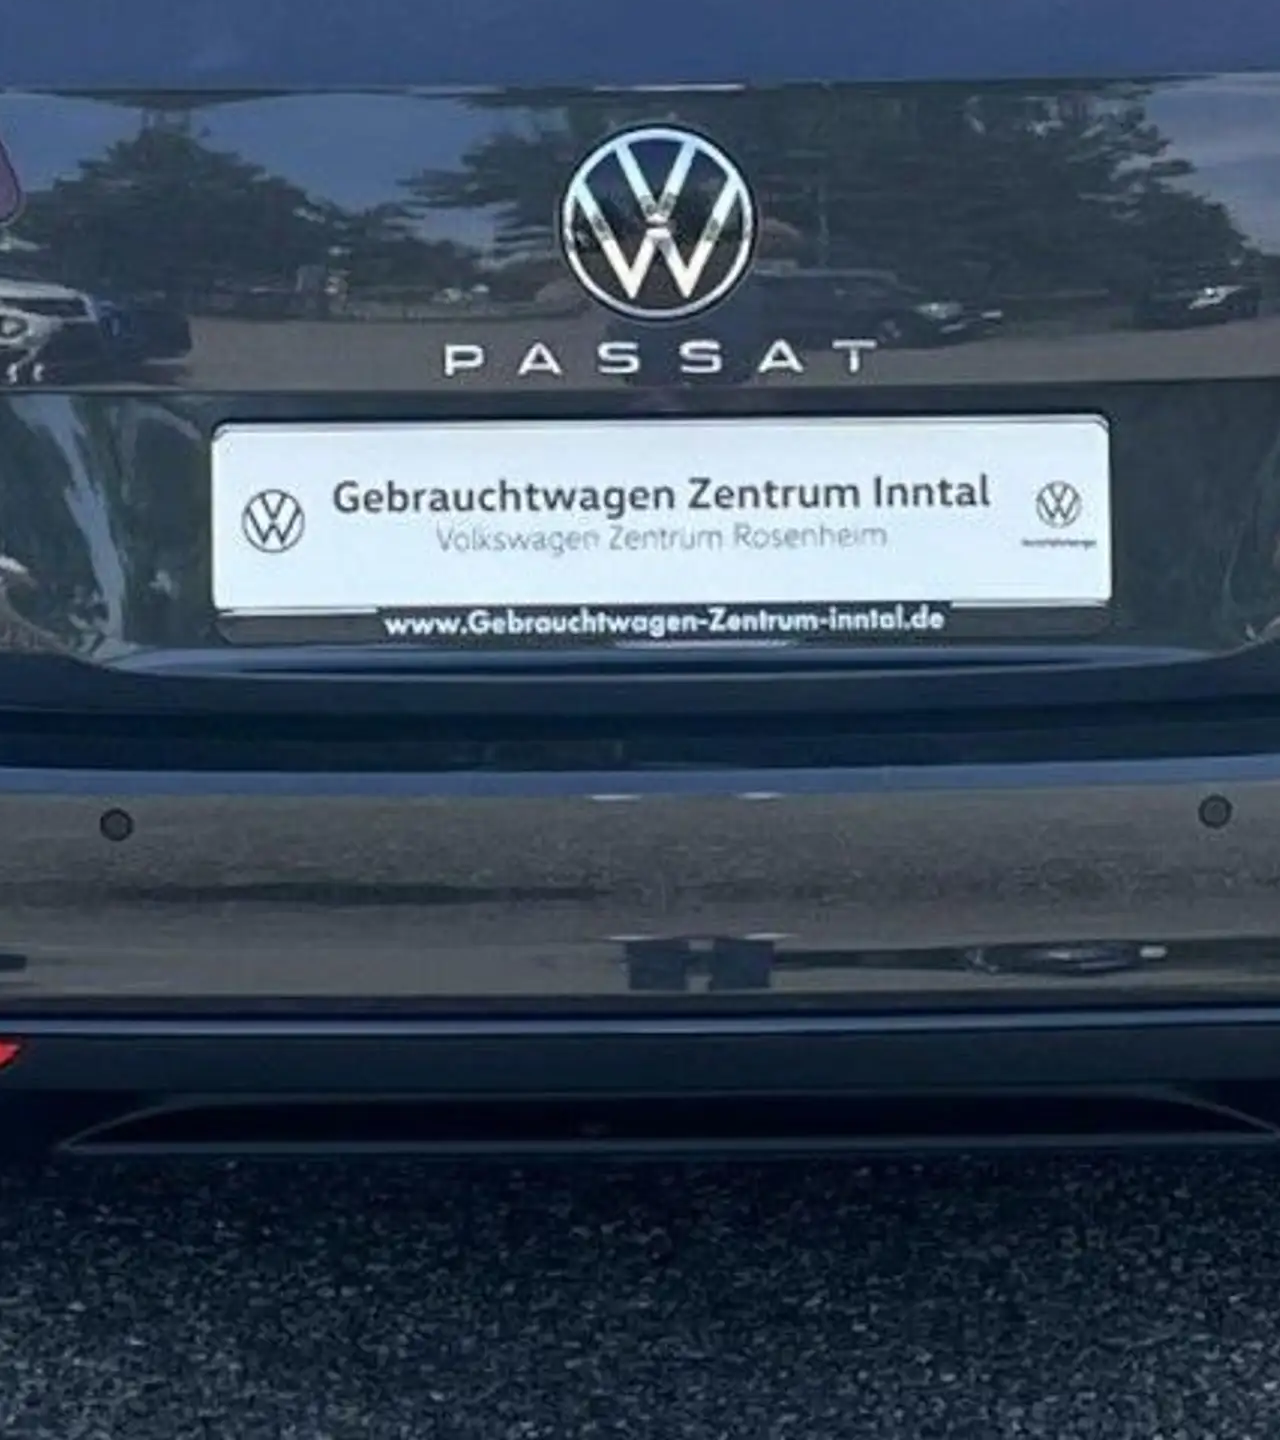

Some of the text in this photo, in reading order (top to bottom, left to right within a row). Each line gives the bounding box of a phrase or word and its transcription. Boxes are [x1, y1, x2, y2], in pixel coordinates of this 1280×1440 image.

[443, 339, 878, 376] PASSAT
[333, 473, 990, 520] Gebrauchtwagen Zentrum Inntal
[436, 522, 888, 558] Volkswagen Zentrum Rosenheim
